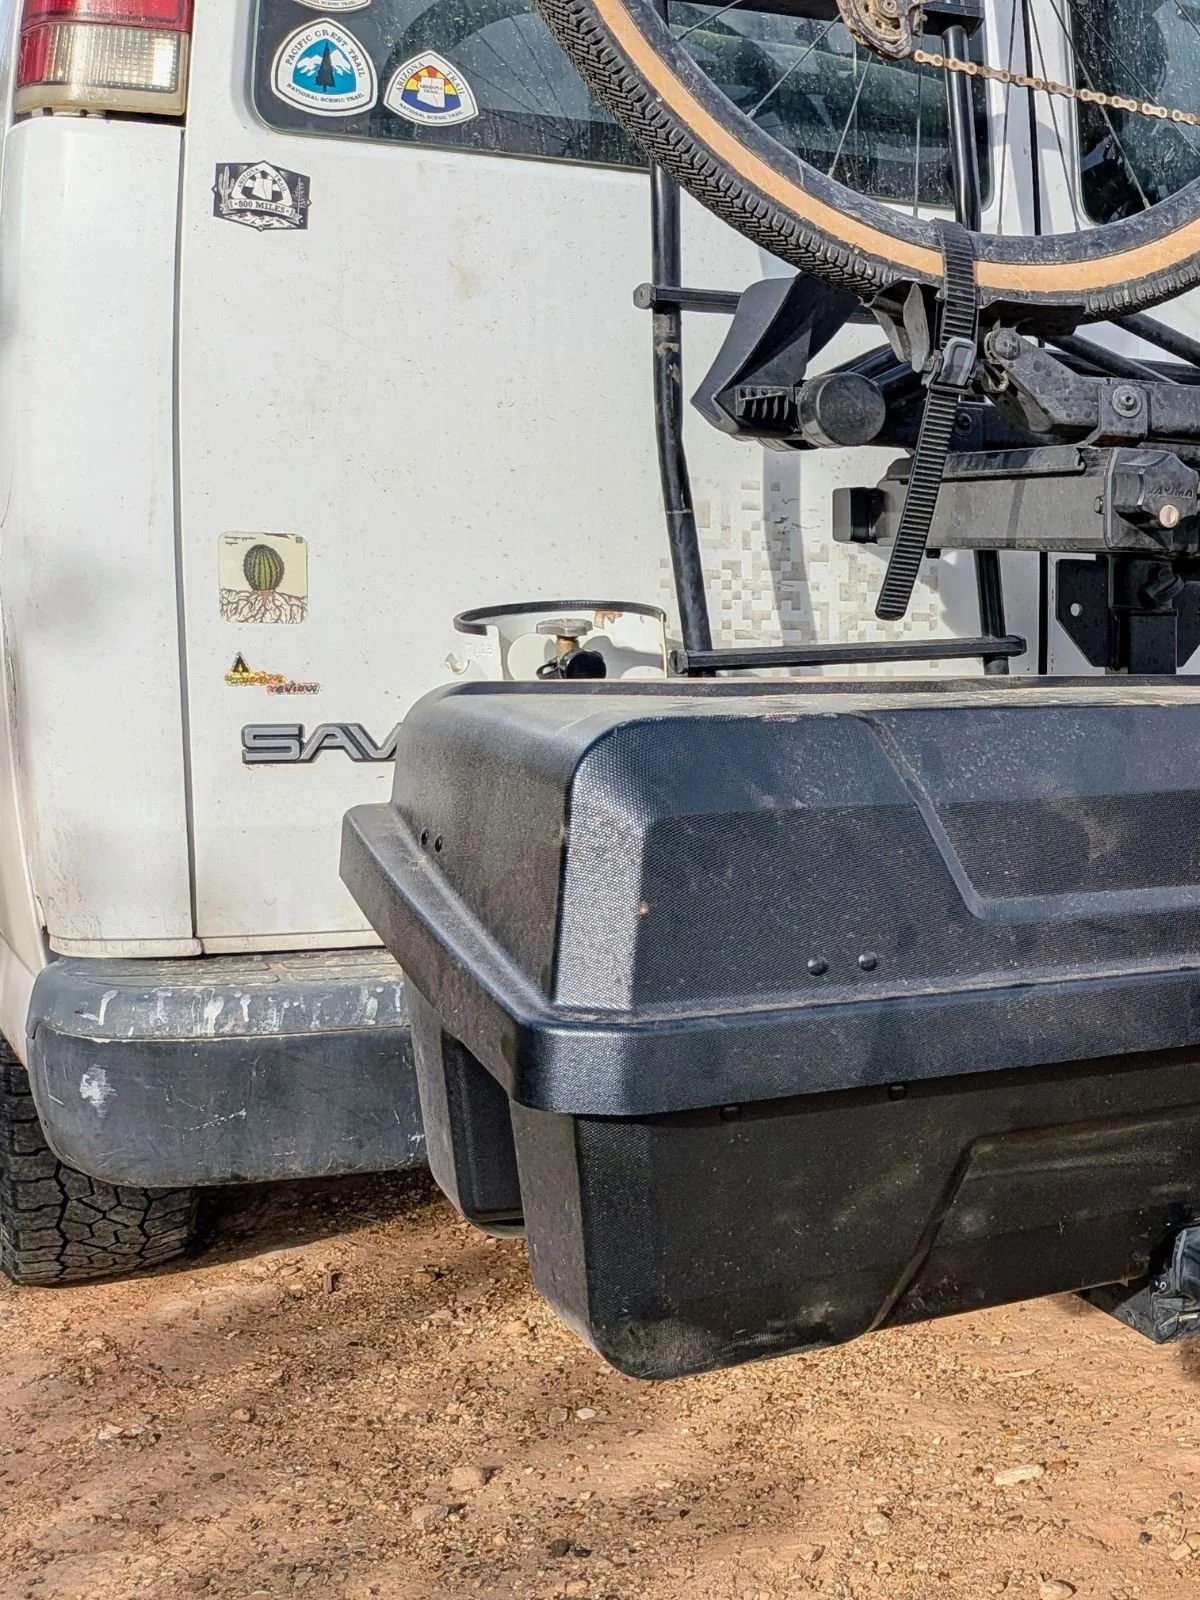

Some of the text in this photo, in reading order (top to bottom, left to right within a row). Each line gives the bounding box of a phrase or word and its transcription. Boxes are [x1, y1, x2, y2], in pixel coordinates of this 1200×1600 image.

[285, 29, 366, 78] PACIFIC CREST TRAIL
[396, 61, 466, 98] ARIZONA TRAIL
[286, 82, 319, 101] NATIONAL
[346, 92, 365, 103] TRAIL
[399, 102, 425, 119] NATIONAL
[448, 110, 464, 119] TRAIL
[237, 167, 288, 192] ARIZONA TRAIL
[238, 200, 286, 213] 800 MILES
